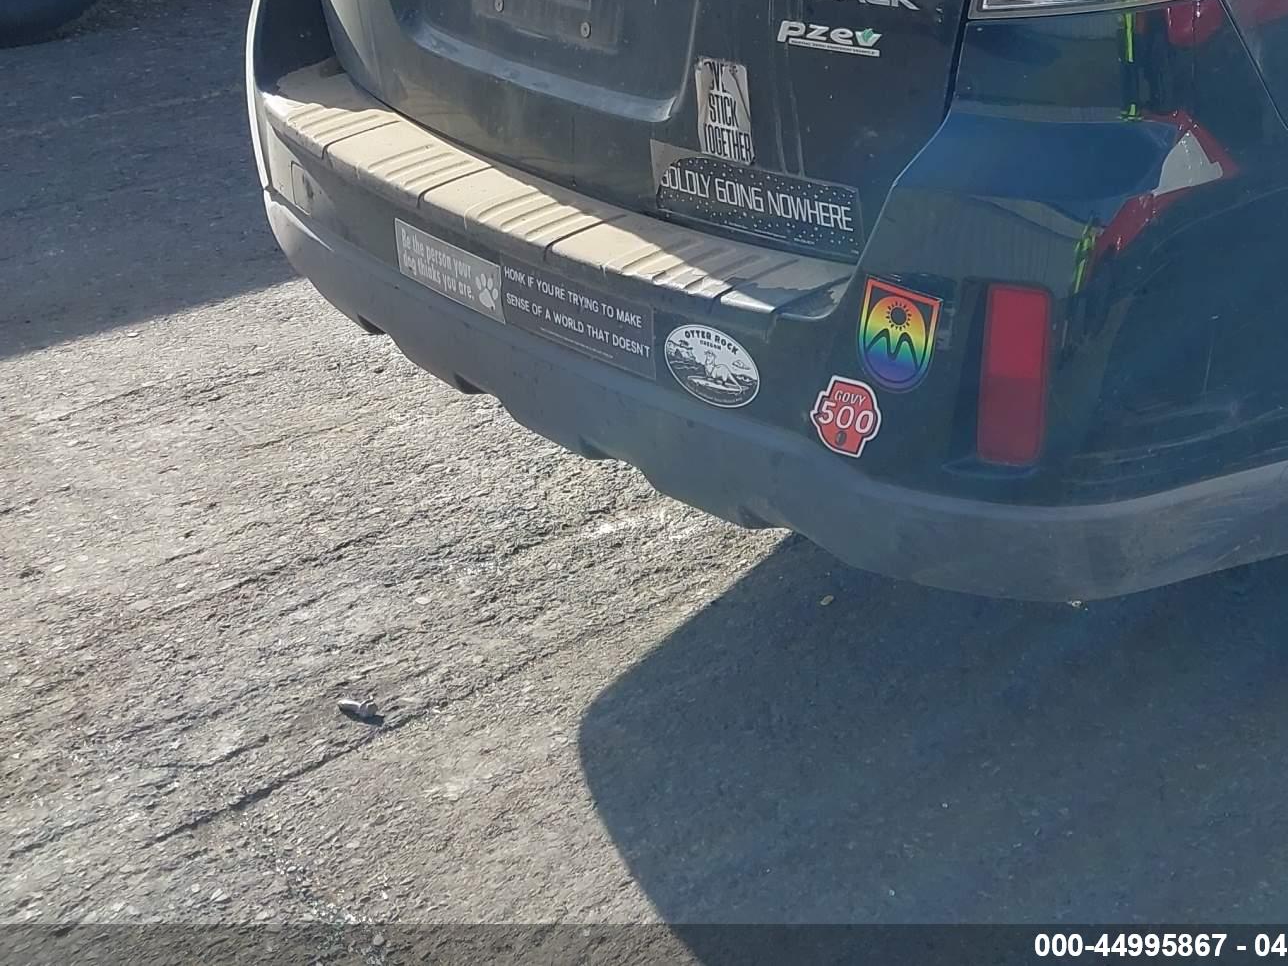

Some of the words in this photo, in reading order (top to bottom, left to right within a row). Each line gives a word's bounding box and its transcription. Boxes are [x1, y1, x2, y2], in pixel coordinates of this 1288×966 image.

[777, 19, 882, 48] pzev
[709, 93, 739, 129] STICK
[704, 123, 753, 162] TOGETHER
[715, 178, 765, 212] GOING
[767, 190, 854, 232] NOWHERE
[401, 227, 411, 250] Be
[412, 234, 425, 257] the
[426, 245, 452, 271] person
[453, 256, 471, 279] your
[403, 249, 417, 276] dog
[417, 256, 441, 284] thinks
[443, 273, 457, 292] you
[504, 265, 526, 285] HONK
[527, 275, 534, 288] IF
[567, 290, 599, 313] TRYING
[601, 303, 614, 318] TO
[616, 308, 642, 328] MAKE
[506, 293, 530, 313] SENSE
[532, 303, 542, 317] OF
[553, 311, 584, 334] WORLD
[586, 324, 610, 343] THAT
[684, 330, 712, 340] OTTER
[715, 335, 739, 355] ROCK
[818, 400, 875, 434] 500
[834, 390, 867, 406] GOVY
